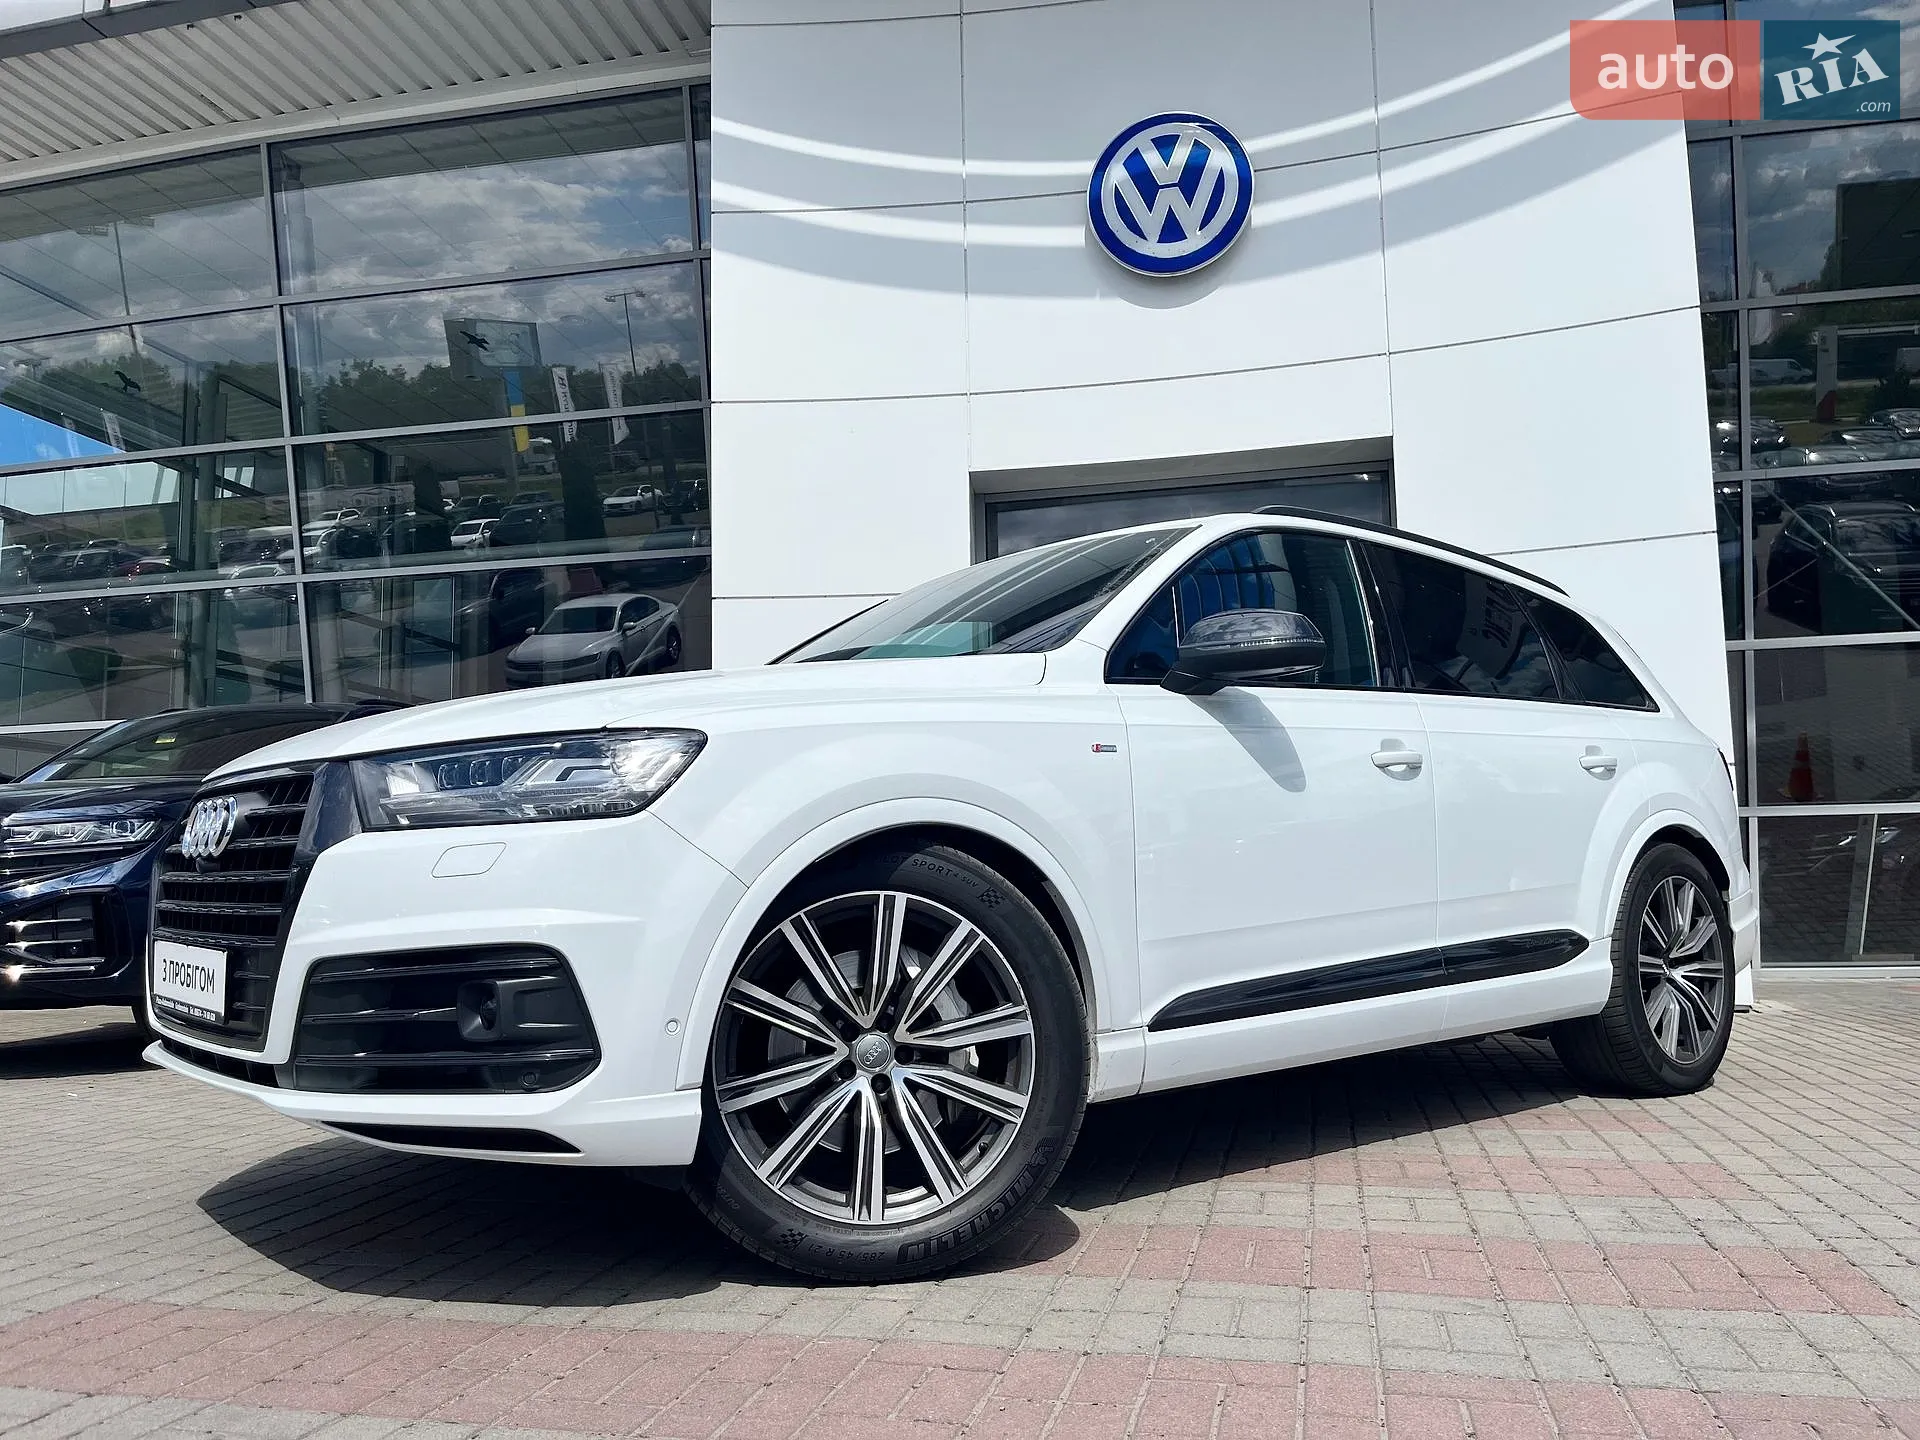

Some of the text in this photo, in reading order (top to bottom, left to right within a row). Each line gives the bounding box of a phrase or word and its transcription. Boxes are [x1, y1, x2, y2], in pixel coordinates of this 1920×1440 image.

[911, 858, 953, 876] SPORT
[960, 876, 979, 887] SUV
[169, 960, 215, 994] ПРОБІГОМ
[903, 1168, 1034, 1261] MICHELIN
[825, 1247, 835, 1257] R
[837, 1250, 885, 1261] 285/45
